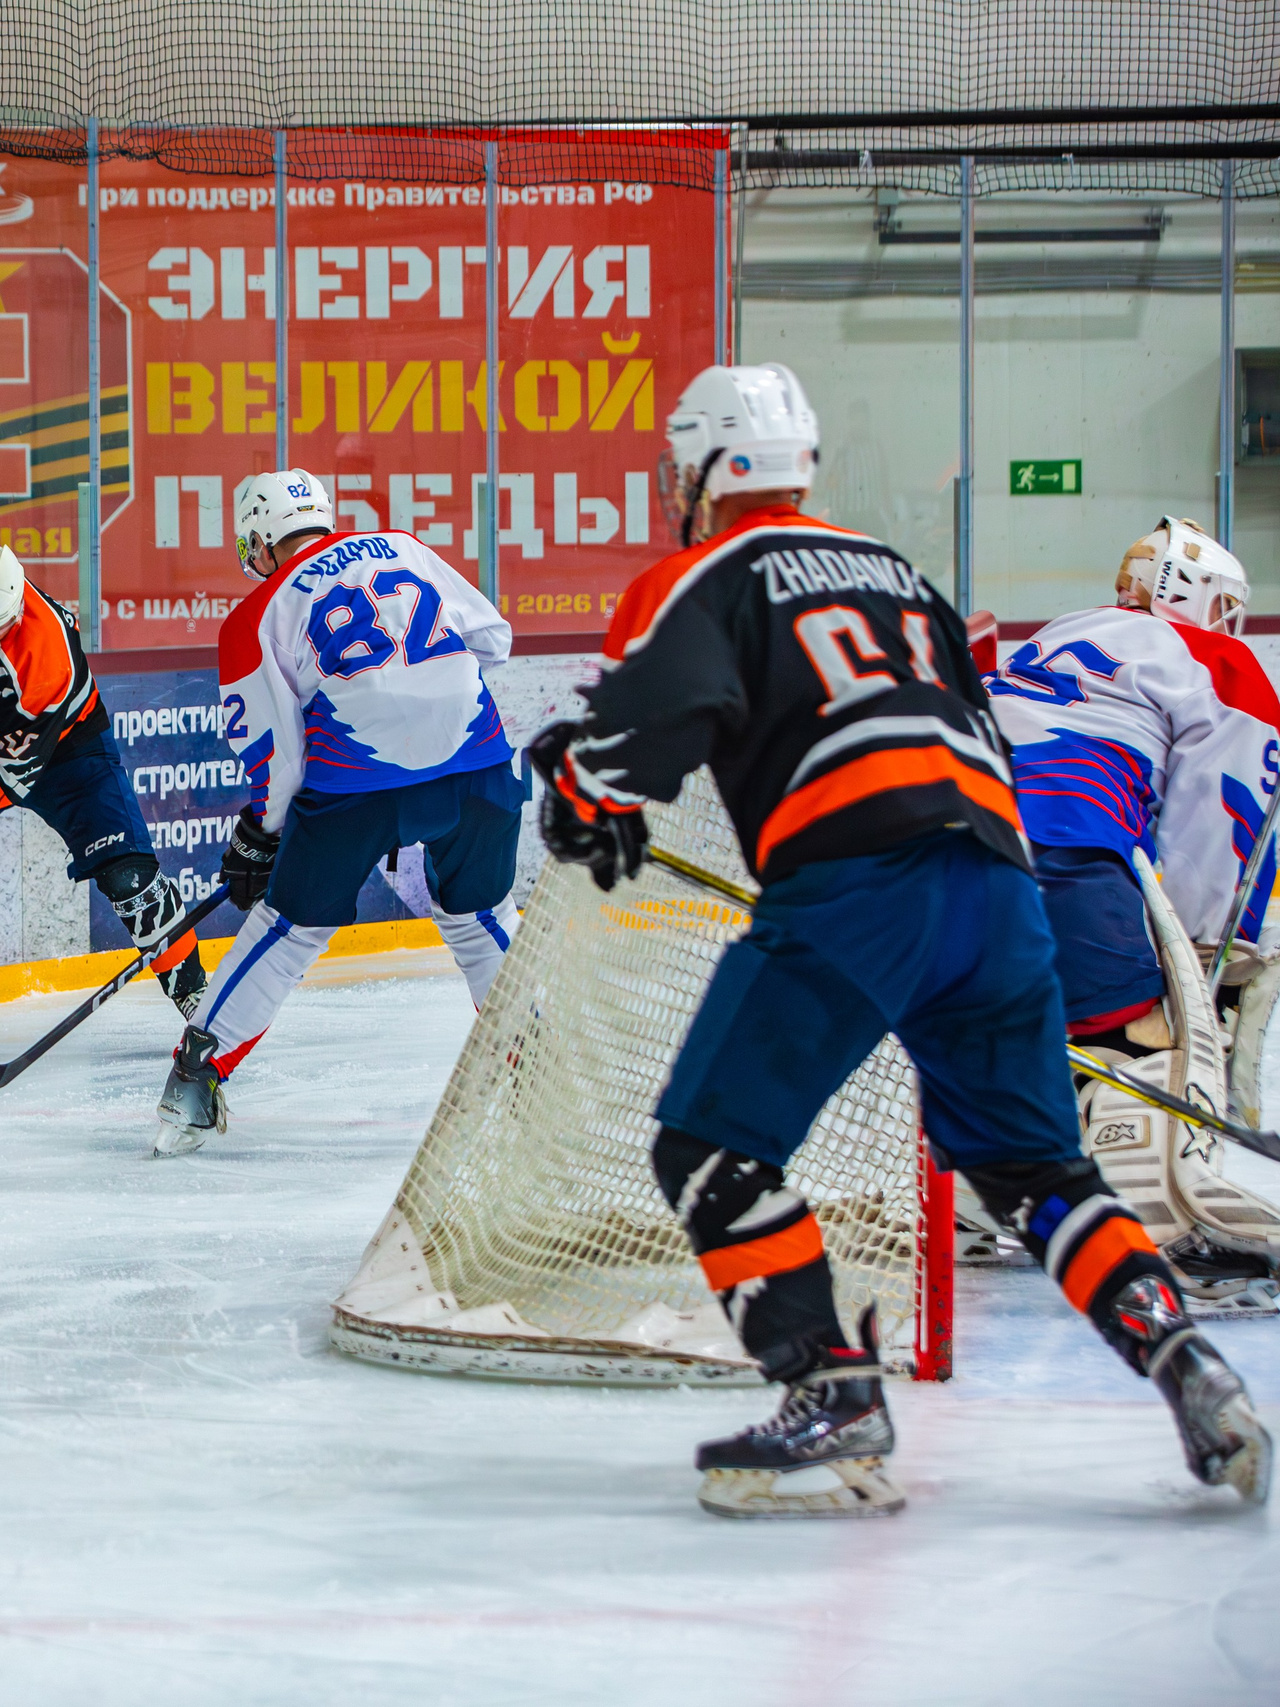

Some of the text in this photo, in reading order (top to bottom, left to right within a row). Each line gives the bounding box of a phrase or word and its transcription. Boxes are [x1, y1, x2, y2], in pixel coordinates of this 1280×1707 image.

[604, 181, 653, 205] РФ
[147, 245, 651, 320] ЭНЕРГИЯ
[146, 330, 655, 435] ВЕЛИКОЙ
[154, 471, 650, 559] ПБЕДЫ
[287, 483, 311, 498] 82
[291, 536, 399, 595] ГУСАРОВ
[305, 567, 476, 681] 82
[517, 593, 592, 614] 2026
[85, 832, 126, 857] CCM
